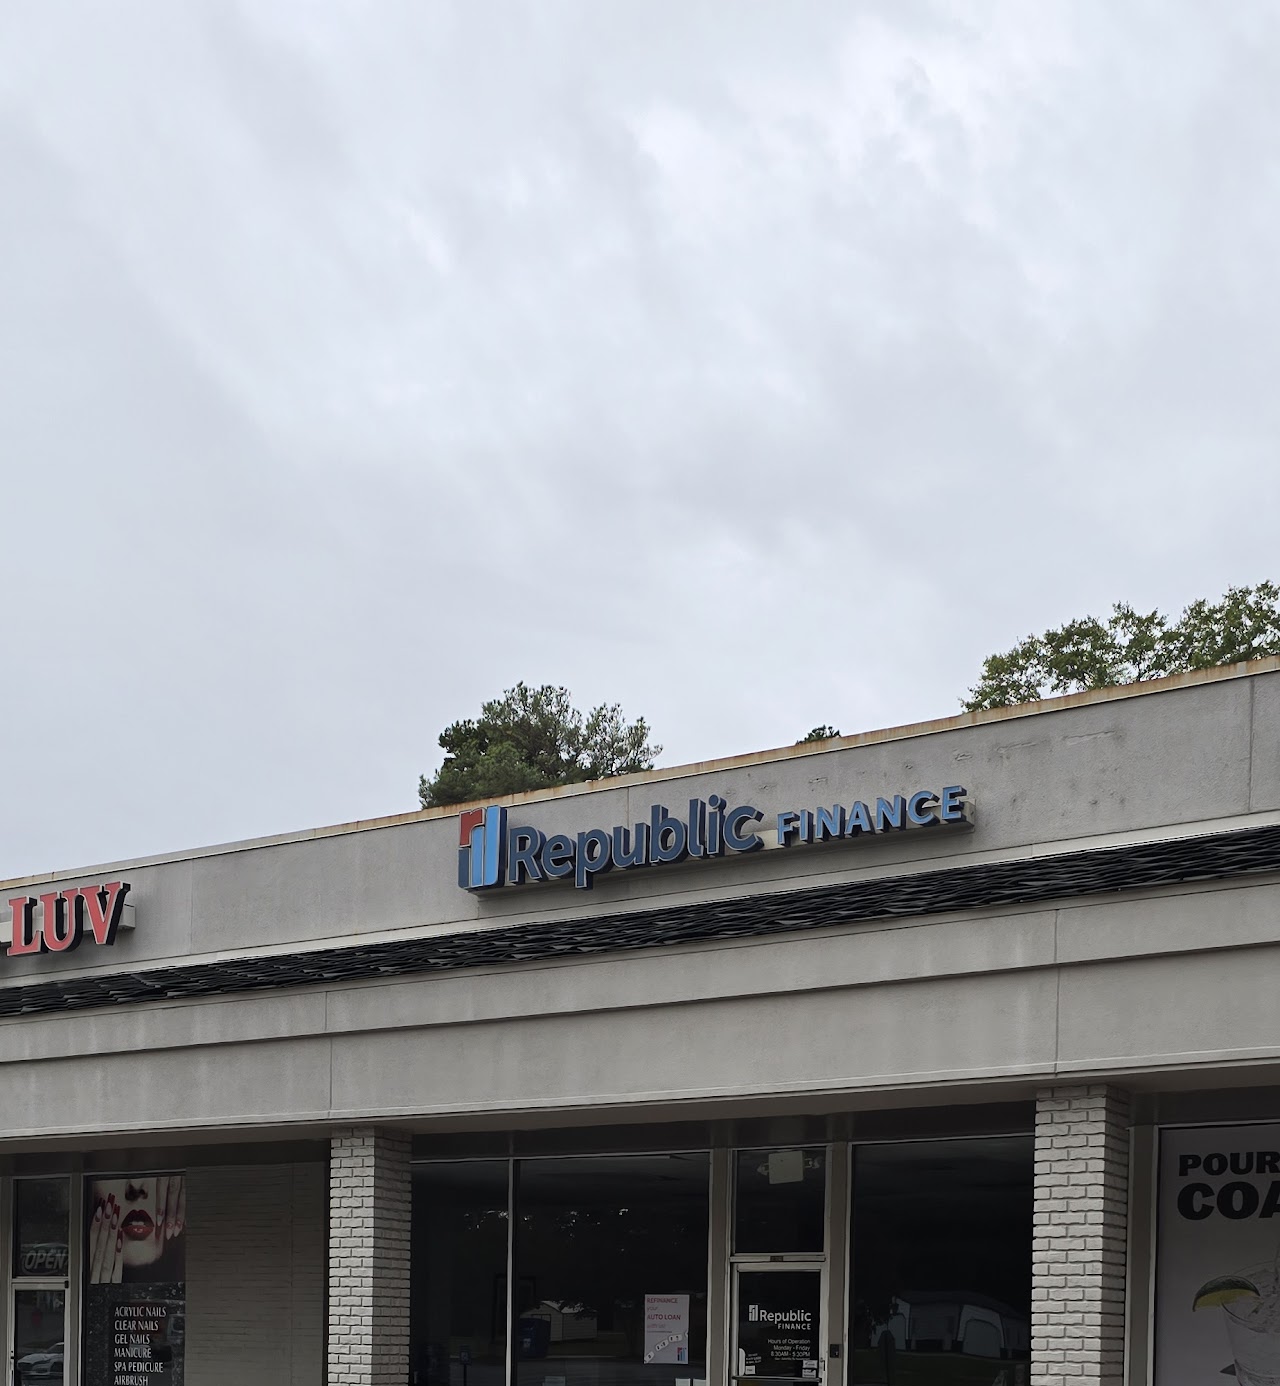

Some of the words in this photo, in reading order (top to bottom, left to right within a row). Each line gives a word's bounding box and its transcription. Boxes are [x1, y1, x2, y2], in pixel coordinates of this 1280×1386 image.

[508, 794, 764, 889] Republic
[776, 785, 967, 847] FINANCE
[7, 881, 131, 956] LUV
[1178, 1151, 1280, 1176] POUR
[25, 1249, 67, 1270] OPEN
[114, 1306, 145, 1317] ACRYLIC
[145, 1306, 167, 1318] NAILS
[760, 1310, 811, 1324] Republic
[114, 1320, 137, 1331] CLEAR
[138, 1320, 159, 1331] NAILS
[114, 1333, 128, 1345] GEL
[130, 1333, 151, 1345] NAILS
[114, 1347, 152, 1359] MANICURE
[114, 1361, 127, 1372] SPA
[128, 1361, 164, 1373] PEDICURE
[114, 1375, 149, 1386] AIRBRUSH
